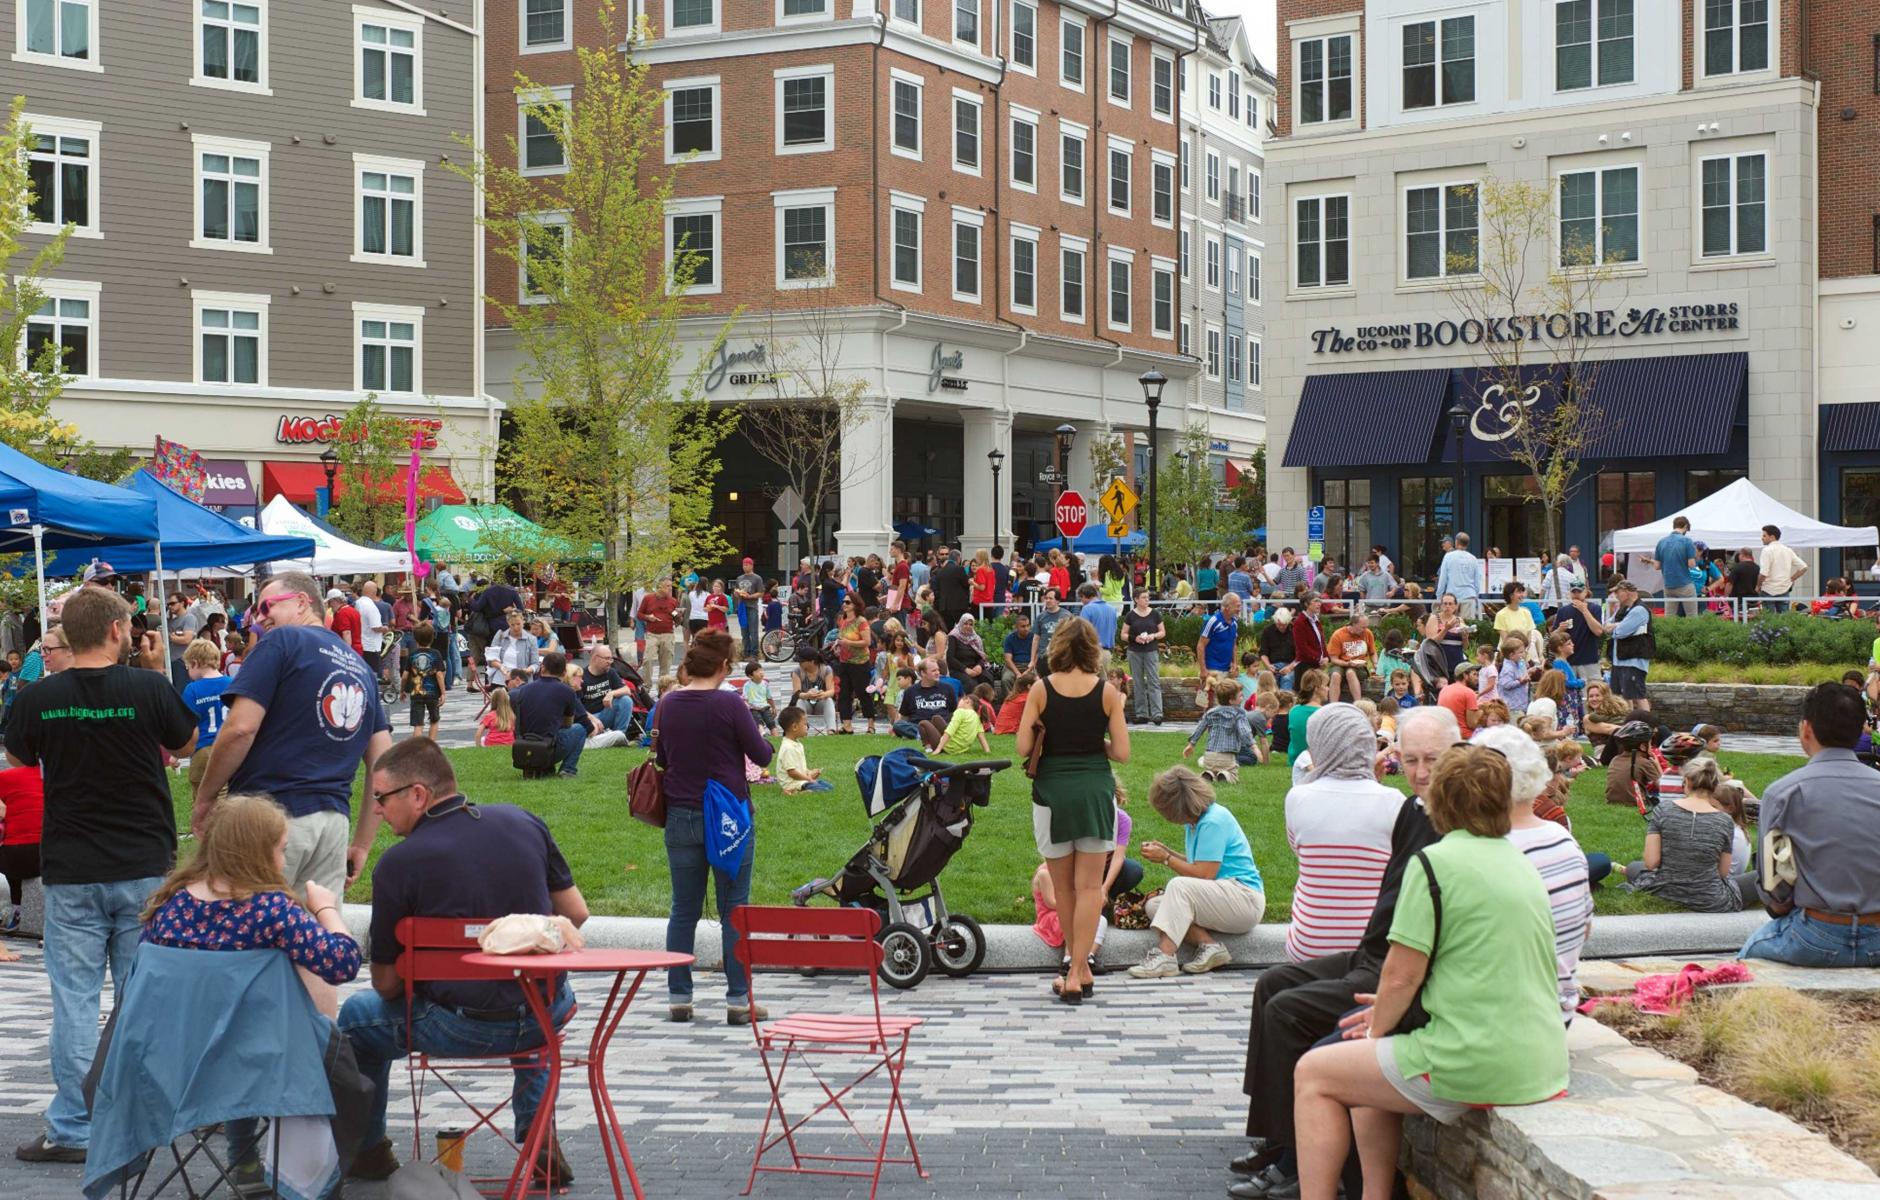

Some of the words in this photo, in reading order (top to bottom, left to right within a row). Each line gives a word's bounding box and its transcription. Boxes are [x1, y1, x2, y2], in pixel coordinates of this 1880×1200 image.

[1669, 302, 1738, 320] STORRS
[1356, 324, 1410, 338] UCONN
[1413, 309, 1616, 348] BOOKSTORE
[1619, 308, 1666, 337] At
[1668, 317, 1739, 333] CENTER
[1311, 327, 1355, 353] The
[1057, 506, 1086, 523] STOP
